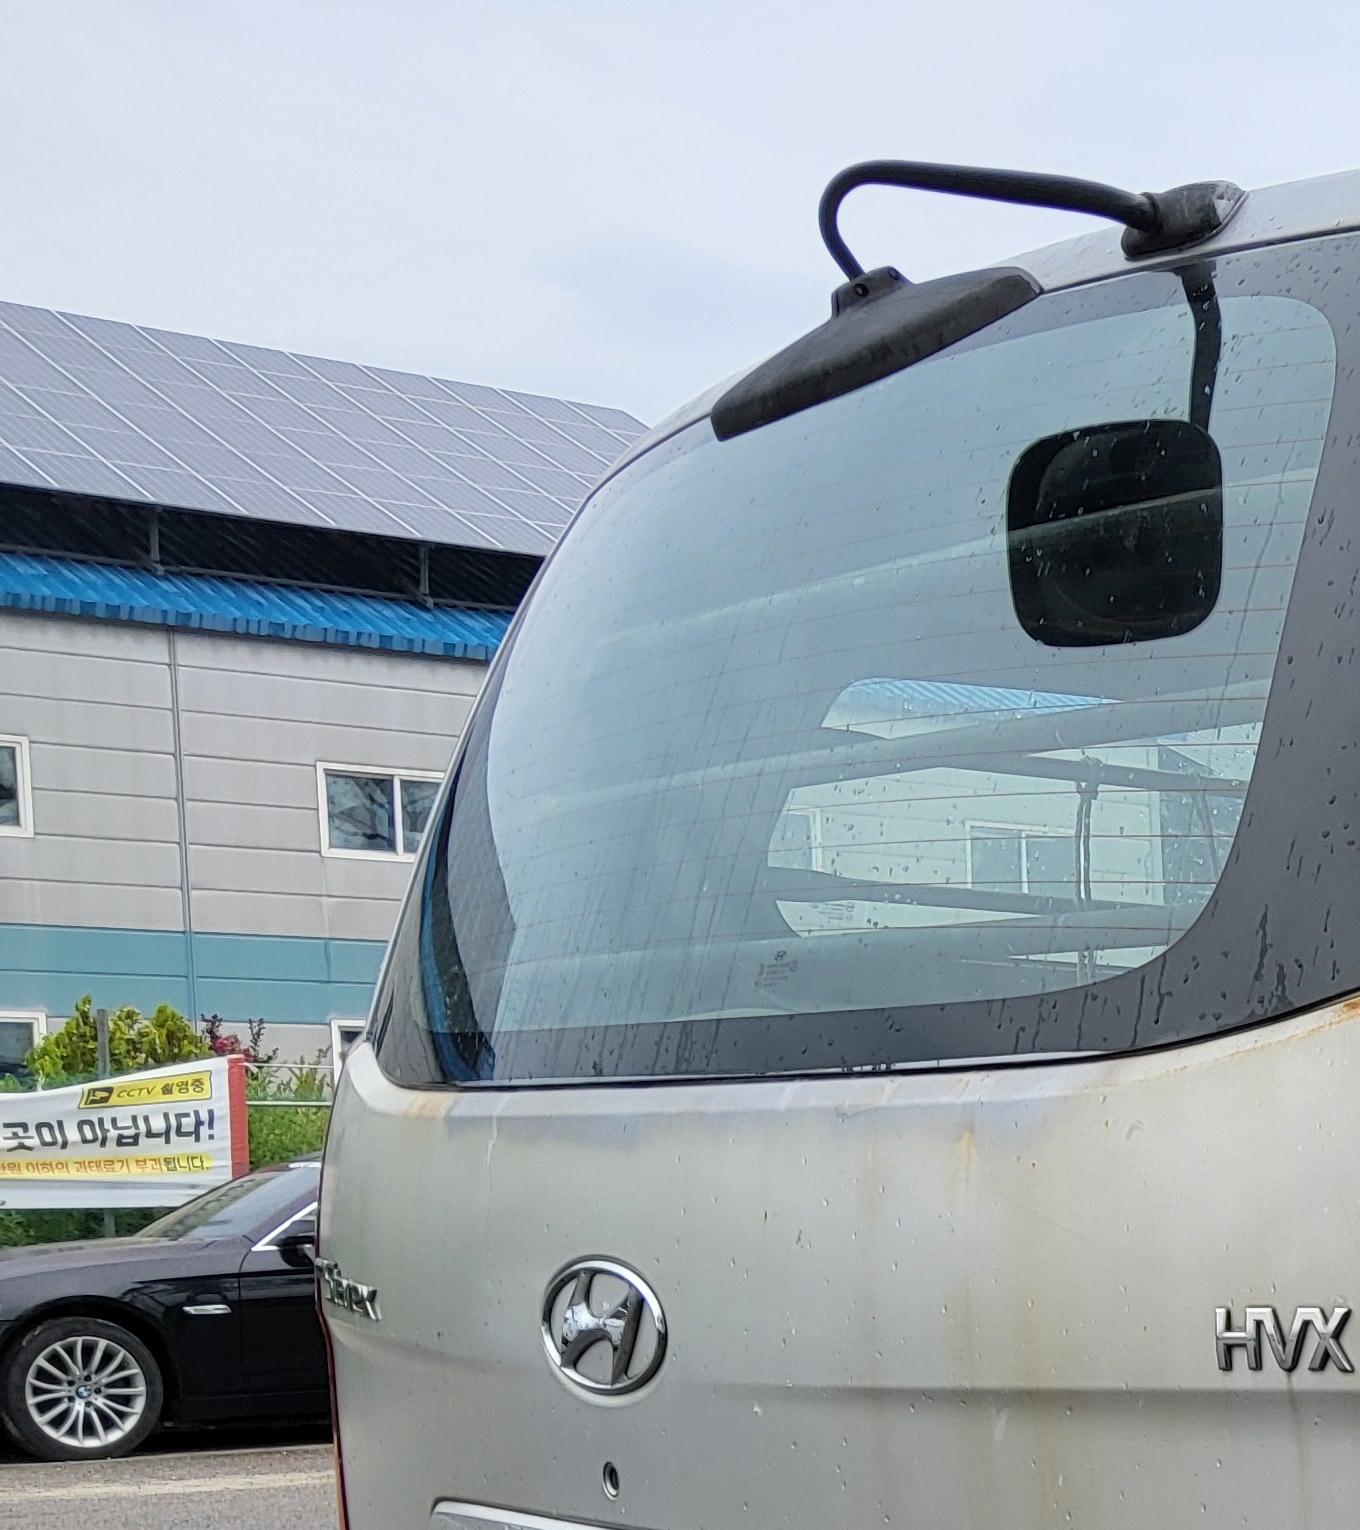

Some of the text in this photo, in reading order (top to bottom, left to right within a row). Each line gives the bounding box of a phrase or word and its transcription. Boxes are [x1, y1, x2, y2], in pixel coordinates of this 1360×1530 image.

[116, 1085, 156, 1099] CCTV
[1, 1108, 215, 1152] 곳이 아닙니다!
[26, 1160, 71, 1175] 이하의
[1214, 1306, 1355, 1374] HVX
